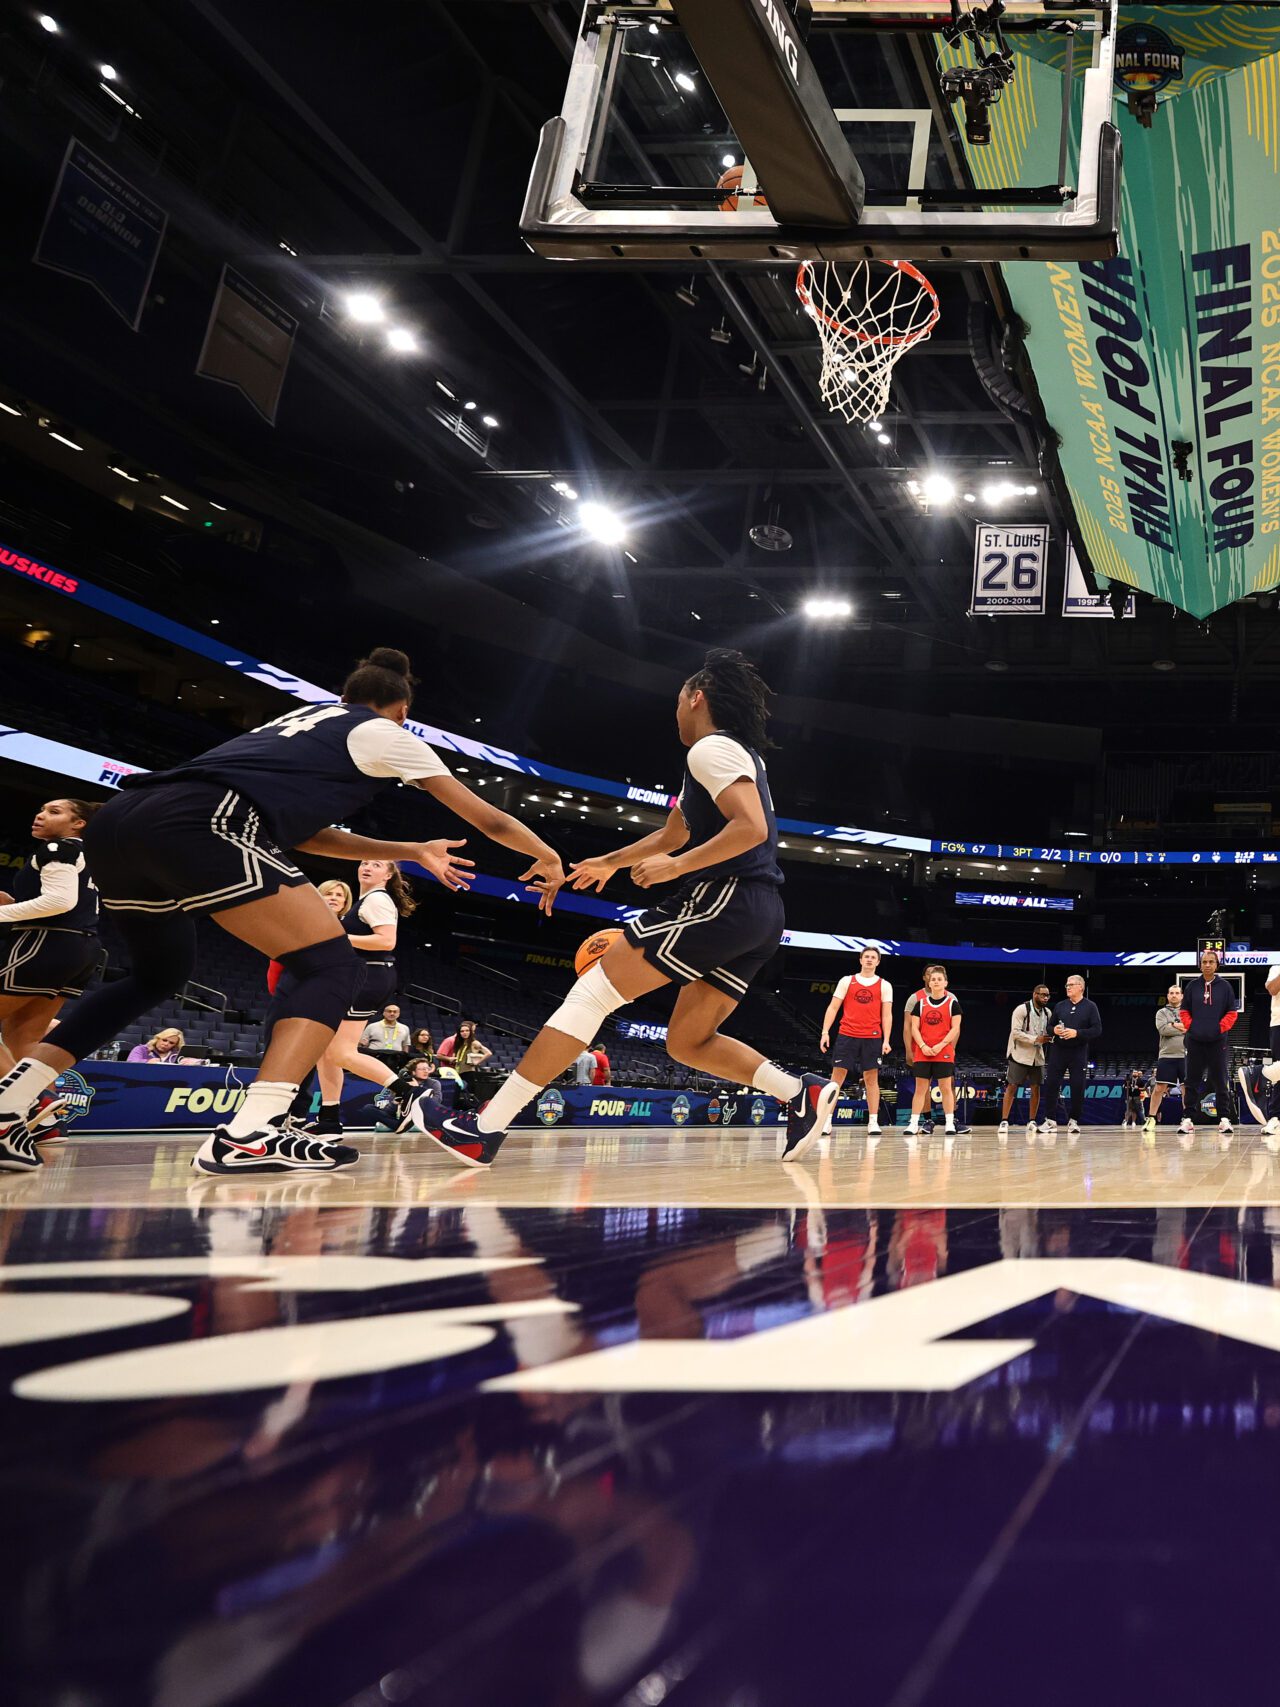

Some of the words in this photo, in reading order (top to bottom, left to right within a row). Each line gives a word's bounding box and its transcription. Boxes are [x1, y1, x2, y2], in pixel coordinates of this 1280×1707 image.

[760, 0, 798, 81] ING
[1115, 52, 1140, 68] NAL
[1144, 52, 1180, 70] FOUR
[1046, 261, 1099, 390] WOMEN
[1191, 243, 1252, 438] FINAL
[1081, 393, 1117, 472] NCAA
[1114, 425, 1173, 554] FINAL
[1207, 439, 1255, 553] FOUR
[1102, 478, 1128, 533] 2025
[984, 534, 1002, 547] ST.
[1006, 534, 1041, 547] LOUIS
[0, 547, 79, 593] USKIES
[981, 551, 1039, 591] 26
[986, 597, 1031, 605] 2000-2014
[627, 786, 669, 807] UCONN
[941, 842, 966, 853] FG%
[972, 845, 985, 853] 67
[1013, 847, 1033, 857] 3PT
[1041, 849, 1061, 860] 2/2
[1078, 852, 1092, 861] FT
[1100, 852, 1121, 863] 0/0
[982, 894, 1018, 906] FOUR
[1023, 897, 1048, 908] ALL
[1205, 941, 1223, 950] 3:12
[525, 953, 557, 967] FINAL
[810, 982, 836, 993] FOU
[58, 1092, 88, 1107] FOUR
[590, 1100, 624, 1116] FOUR
[629, 1101, 651, 1116] ALL
[837, 1108, 853, 1119] FOUR
